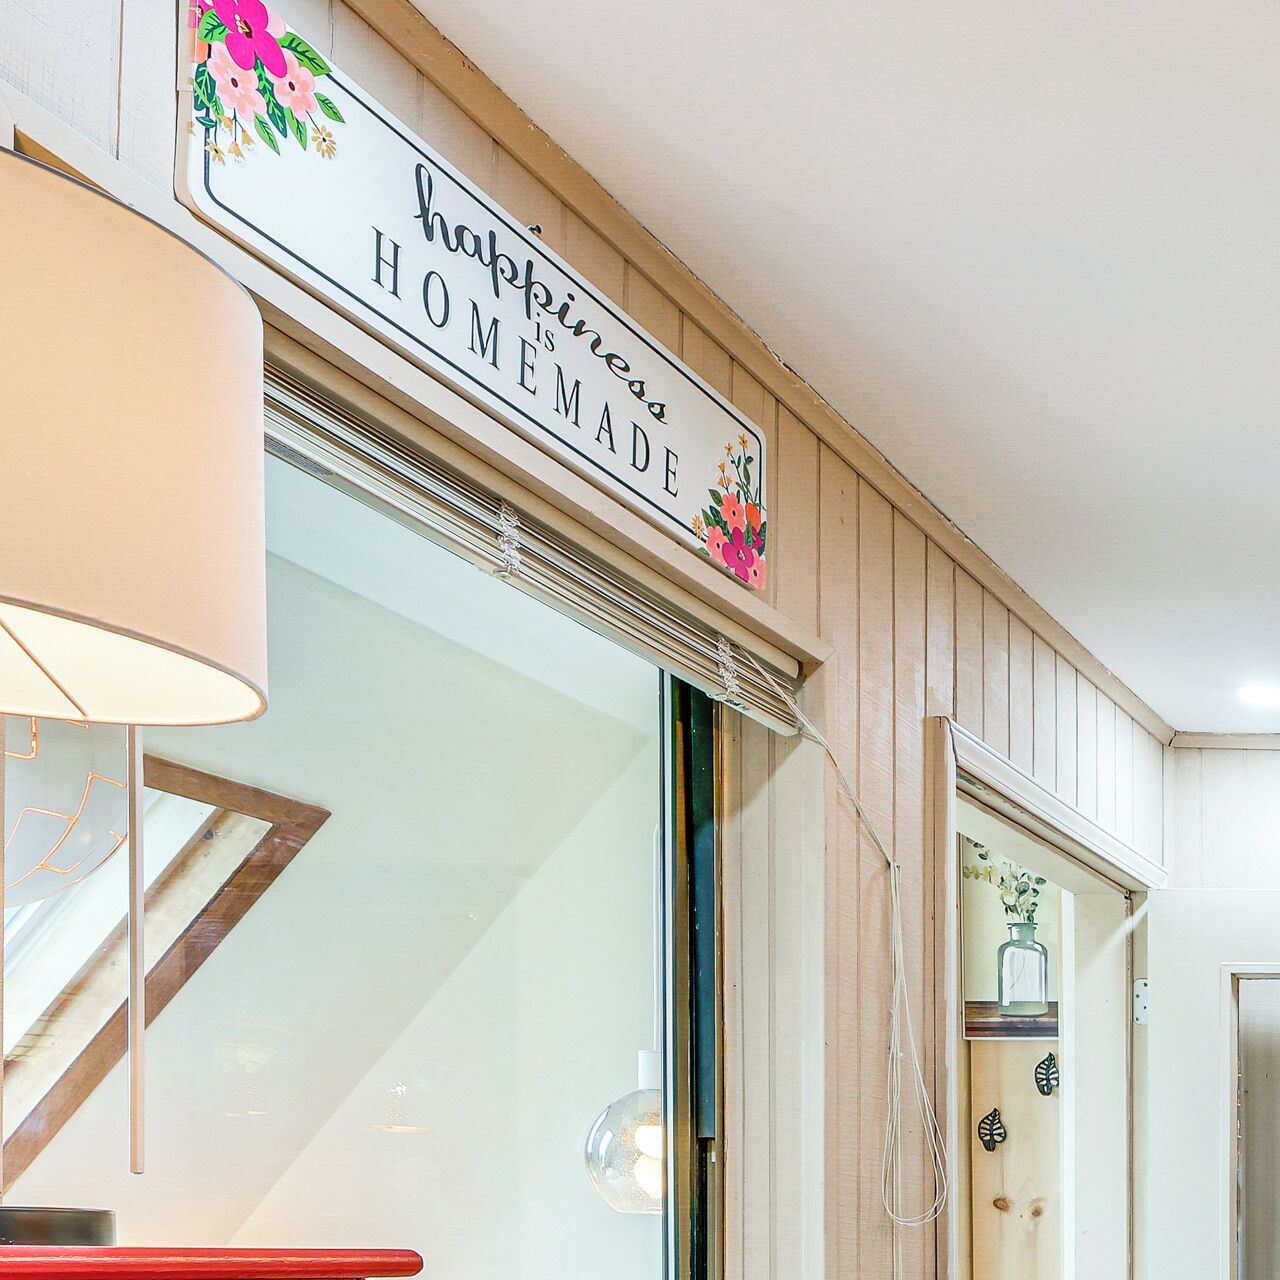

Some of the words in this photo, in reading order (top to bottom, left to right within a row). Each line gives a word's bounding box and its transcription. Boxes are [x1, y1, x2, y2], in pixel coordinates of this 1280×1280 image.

[371, 226, 679, 498] HOMEMADE
[413, 163, 668, 425] happiness
[534, 313, 556, 353] is
